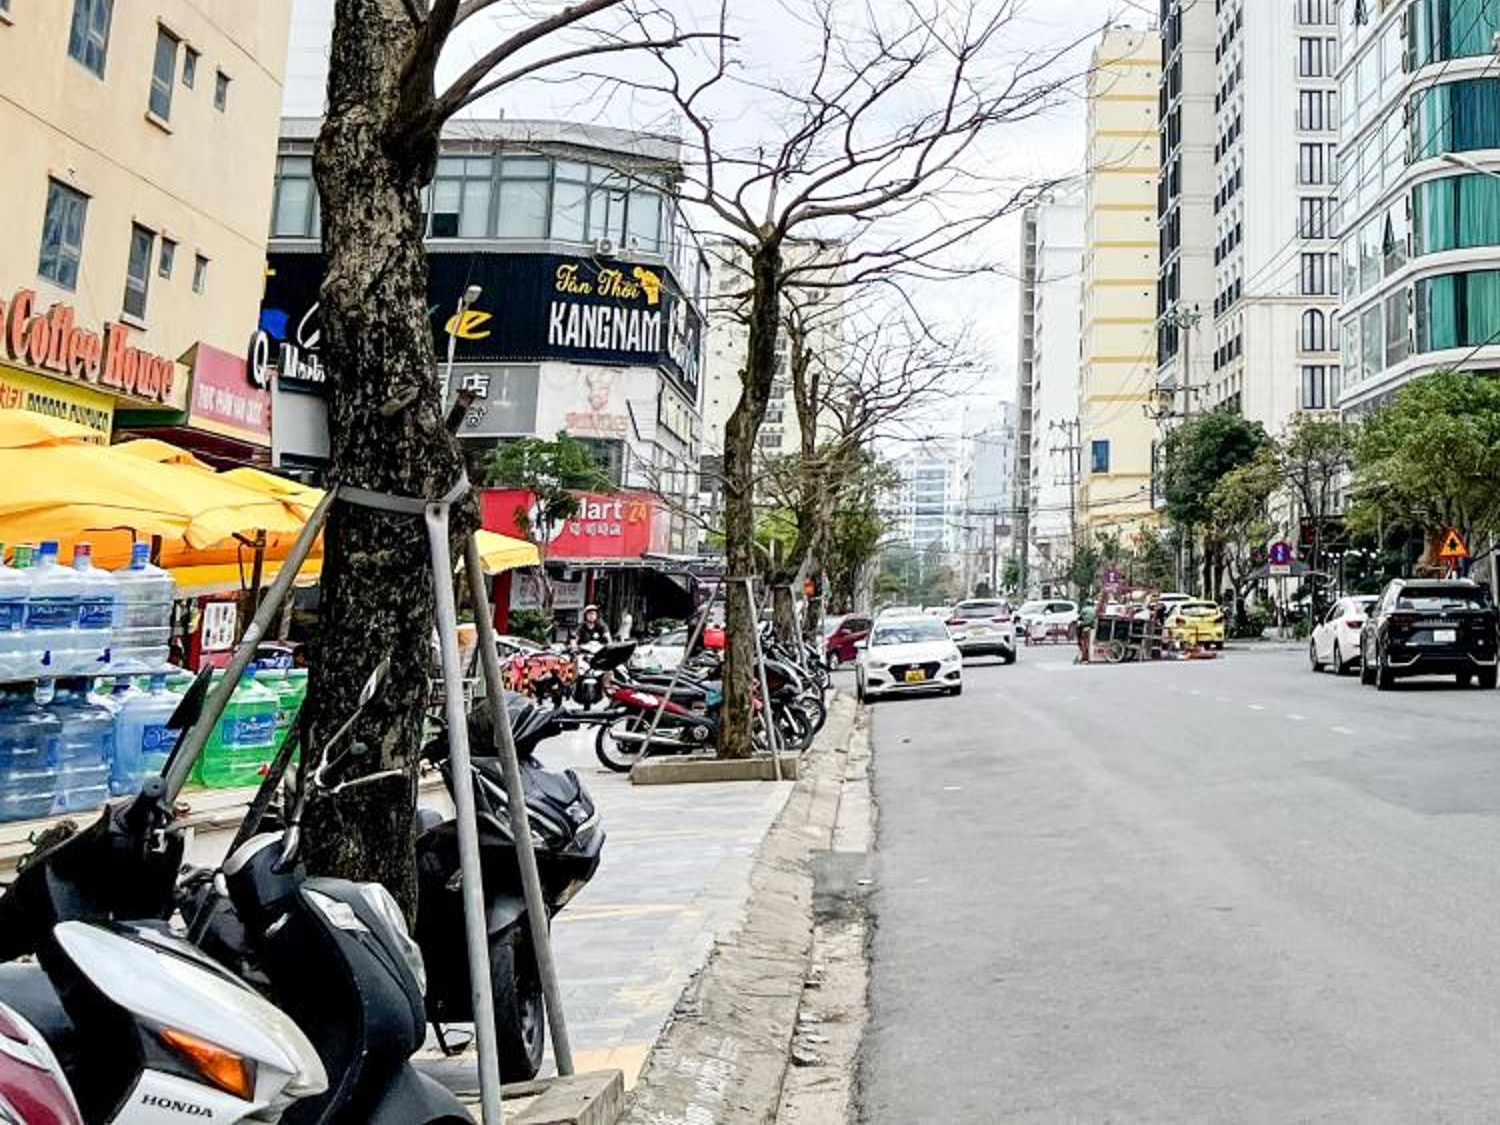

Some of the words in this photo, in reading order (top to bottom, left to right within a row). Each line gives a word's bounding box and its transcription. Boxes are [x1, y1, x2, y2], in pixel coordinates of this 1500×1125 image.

[7, 288, 101, 383] Coffee
[103, 322, 176, 402] House
[549, 301, 662, 352] KANGNAM
[141, 1094, 213, 1119] HONDA
